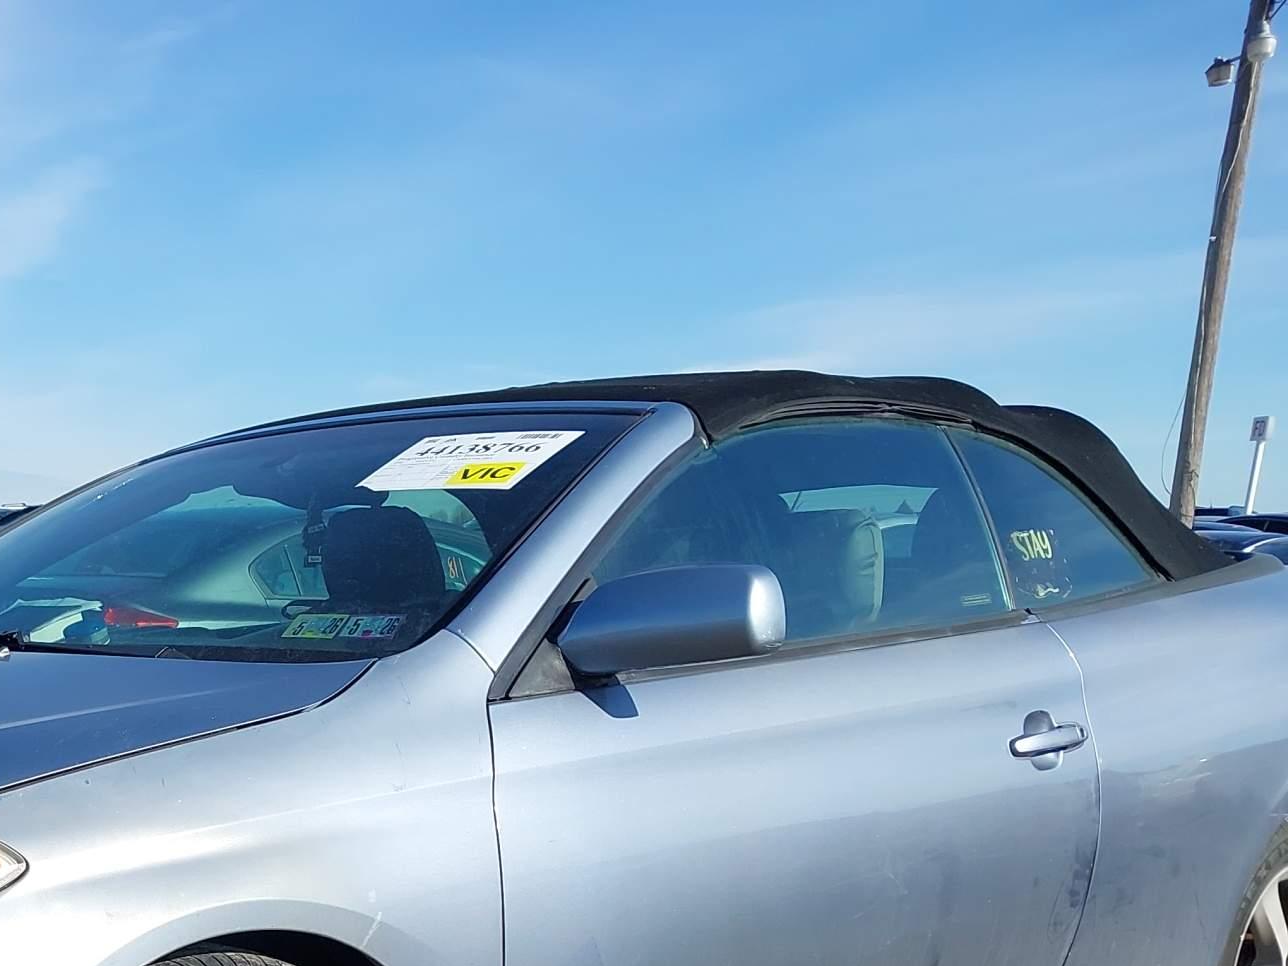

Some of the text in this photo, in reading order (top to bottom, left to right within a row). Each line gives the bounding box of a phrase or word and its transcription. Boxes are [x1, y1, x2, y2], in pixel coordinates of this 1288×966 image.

[415, 441, 542, 457] 44138766
[461, 466, 516, 481] VIC
[1011, 529, 1054, 561] STAY
[292, 621, 307, 636] 5
[348, 618, 364, 636] 5
